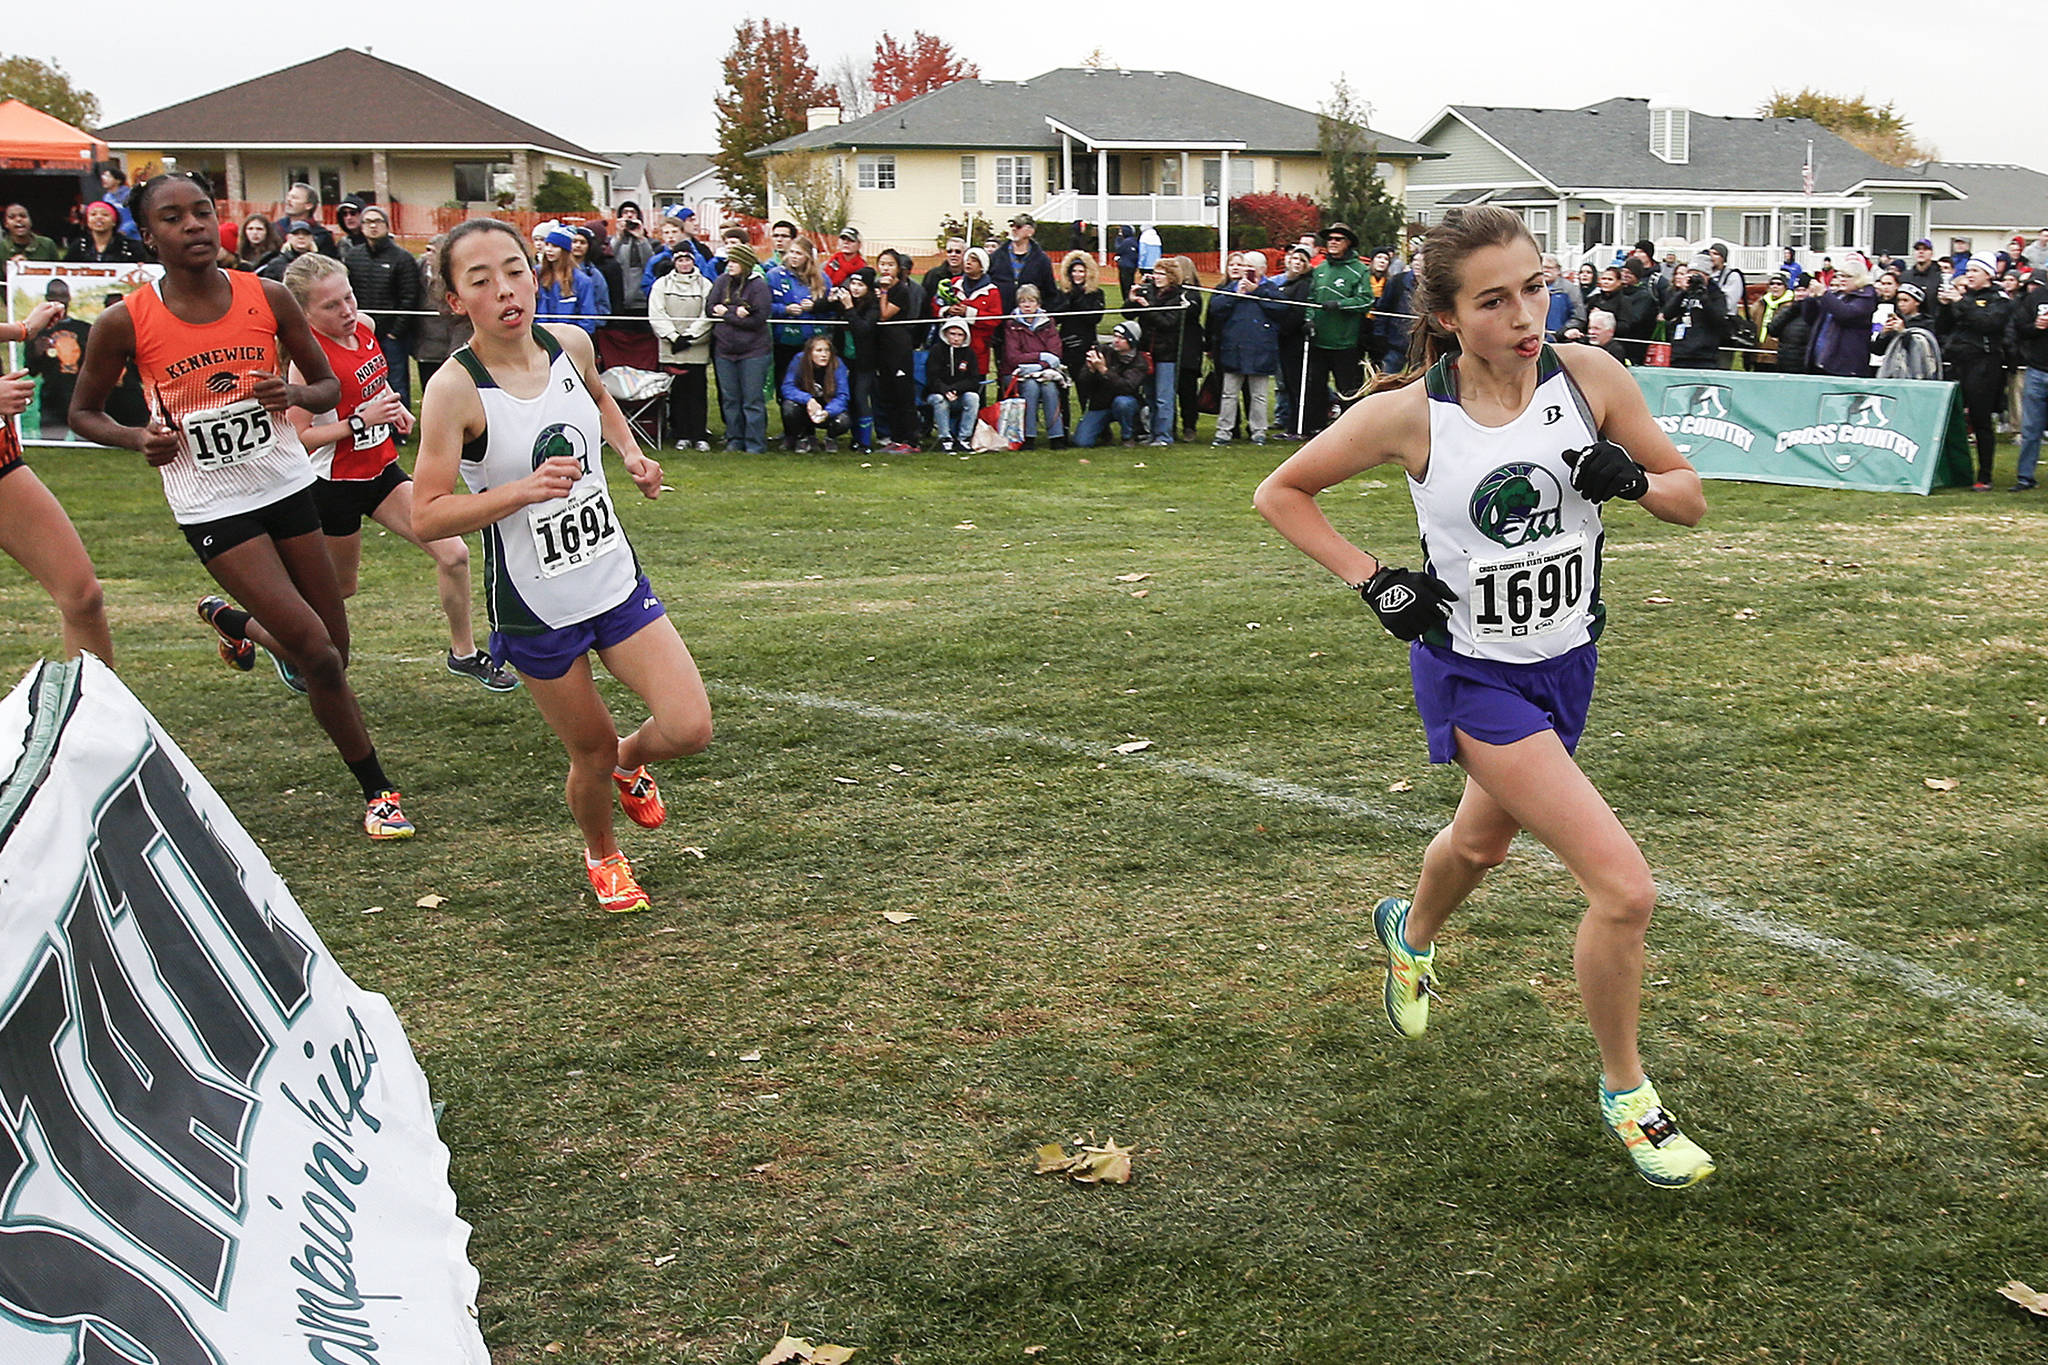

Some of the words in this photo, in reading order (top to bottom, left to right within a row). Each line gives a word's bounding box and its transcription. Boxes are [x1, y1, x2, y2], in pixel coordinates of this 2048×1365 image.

[165, 347, 265, 379] KENNEWICK
[188, 410, 272, 460] 1625
[1680, 415, 1756, 453] COUNTRY
[1774, 423, 1838, 453] CROSS
[1837, 423, 1920, 464] COUNTRY
[536, 496, 615, 564] 1691
[1479, 565, 1498, 573] CROSS
[1500, 561, 1525, 571] COUNTRY
[1475, 555, 1583, 624] 1690
